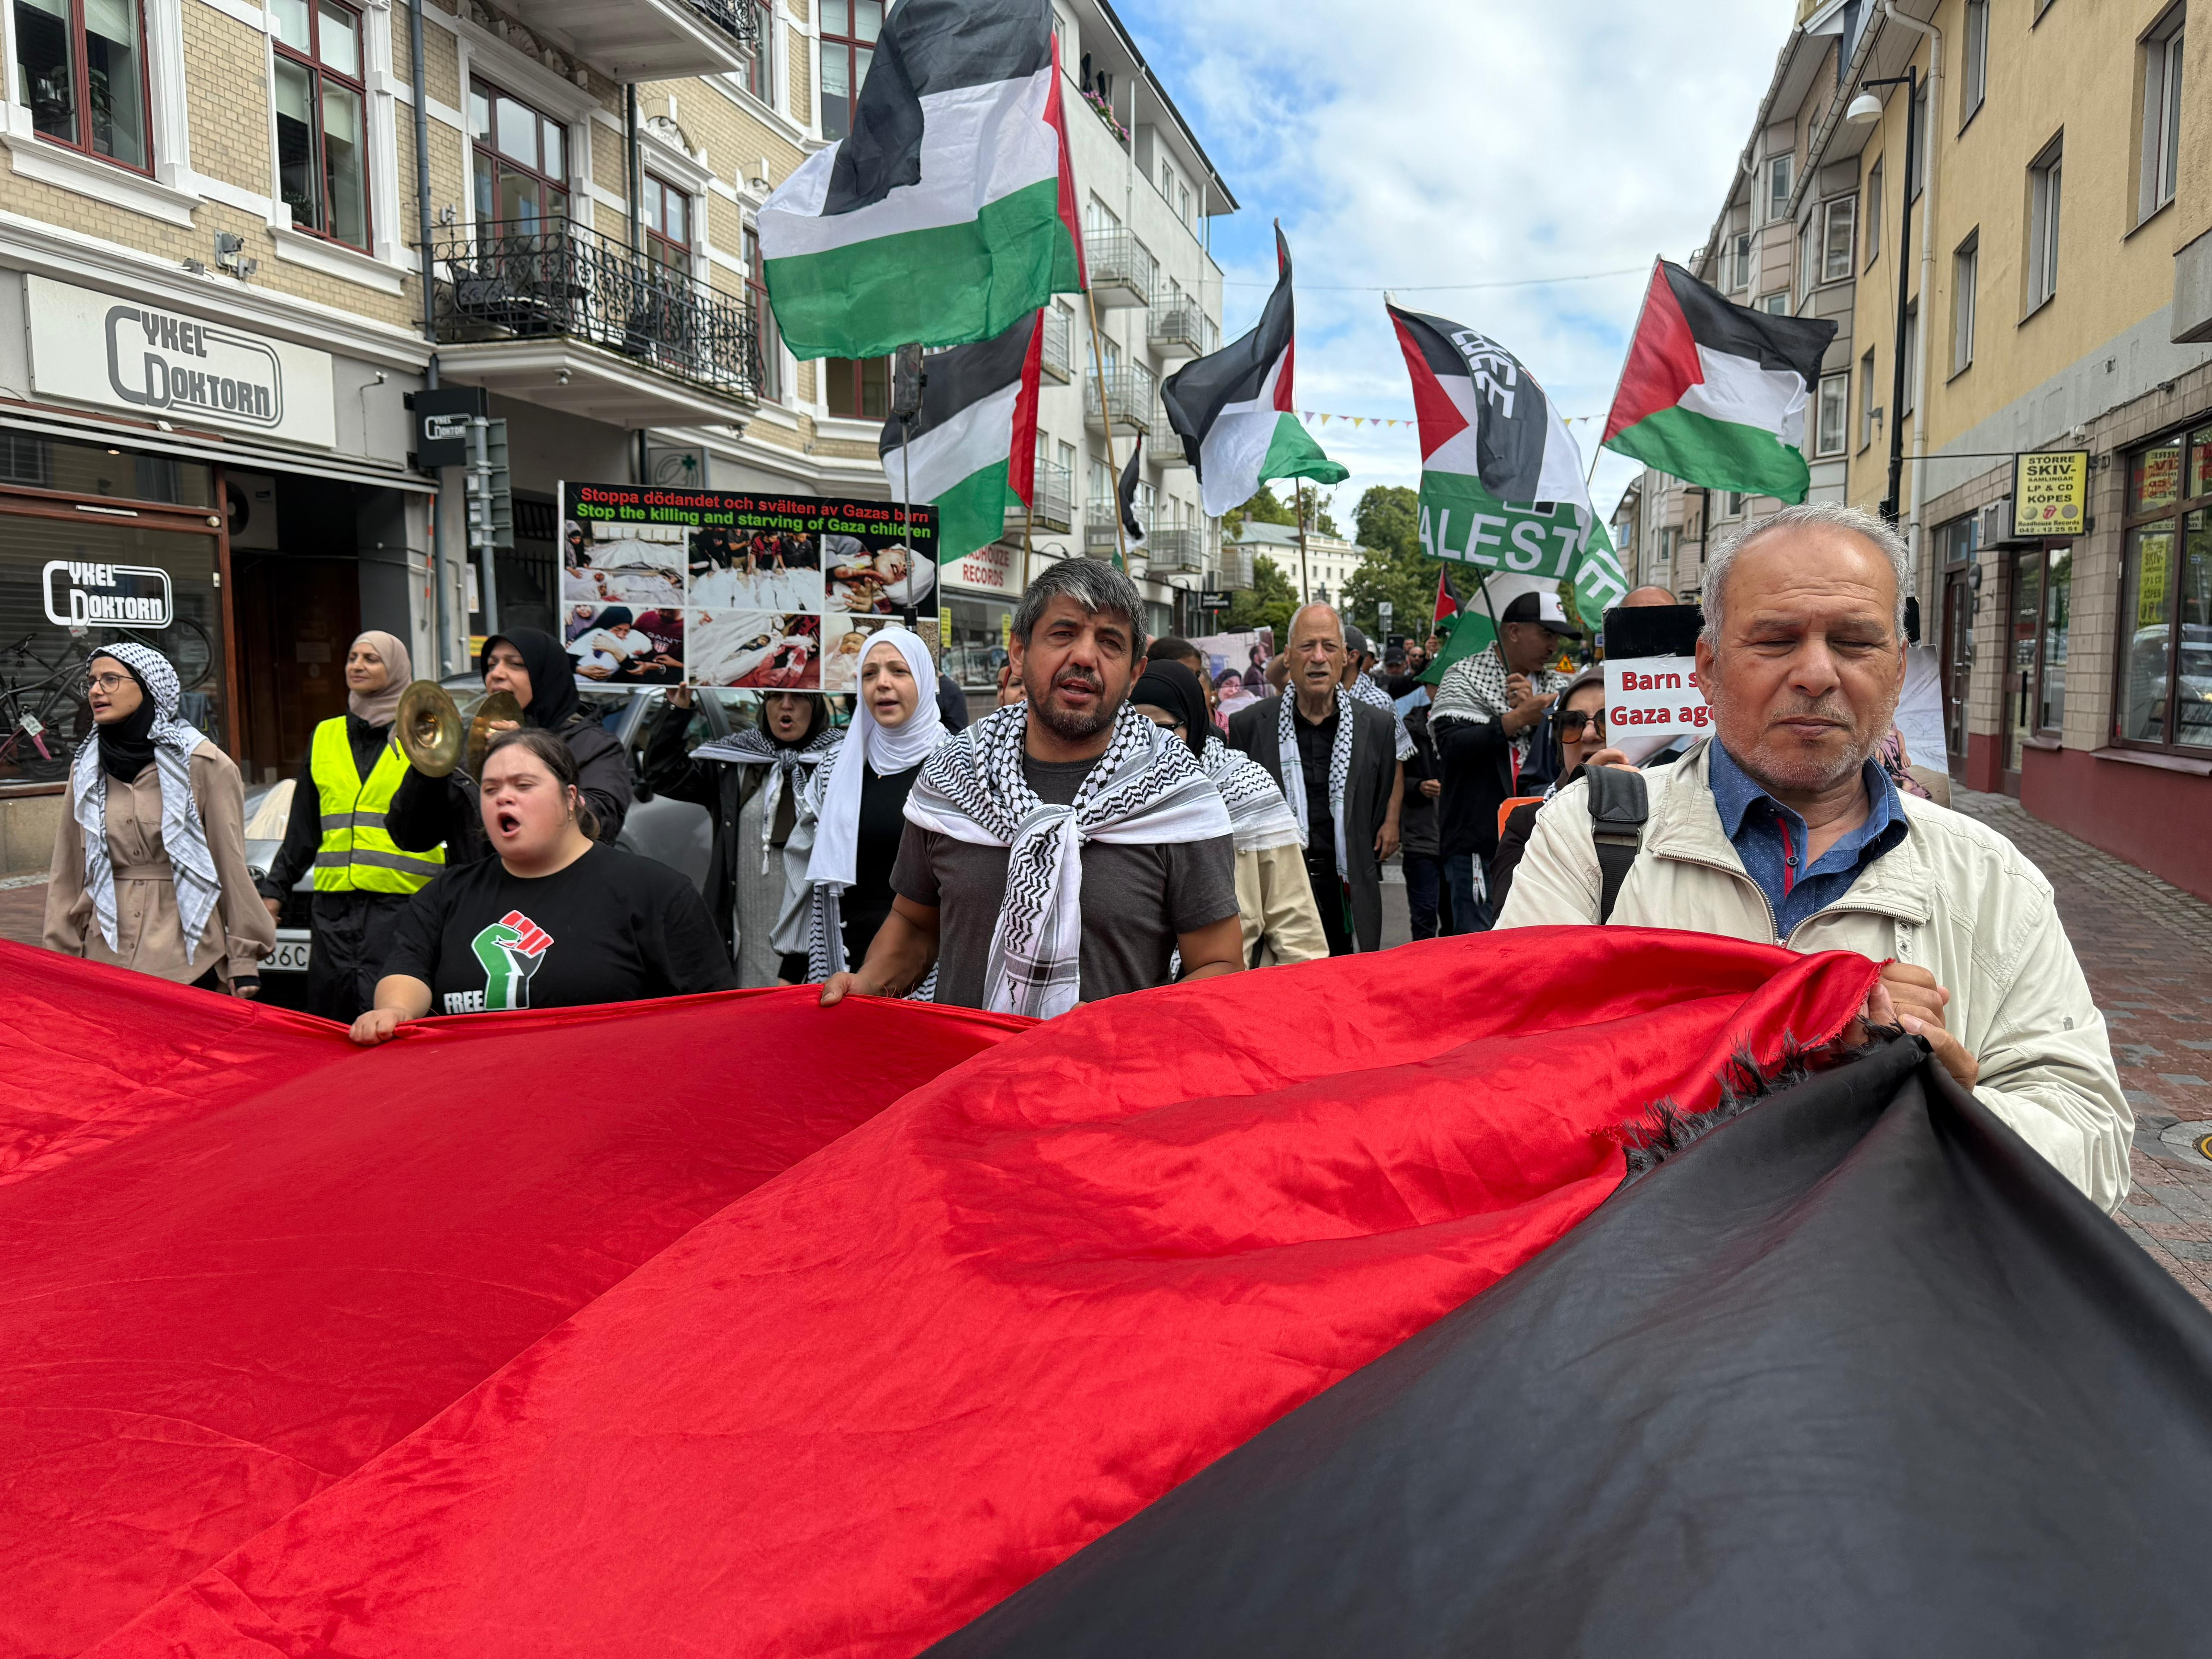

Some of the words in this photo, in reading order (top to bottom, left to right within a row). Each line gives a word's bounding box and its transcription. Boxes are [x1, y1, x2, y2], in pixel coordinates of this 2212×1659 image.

[2029, 455, 2075, 464] STÖRRE
[2027, 464, 2076, 476] SKIV-
[581, 487, 639, 505] Stoppa
[644, 491, 720, 508] dödandet
[724, 496, 753, 511] och
[758, 499, 816, 515] svälten
[821, 505, 839, 516] av
[843, 504, 890, 520] Gazas
[2028, 494, 2072, 503] KÖPES
[576, 502, 616, 521] Stop
[619, 505, 646, 519] the
[650, 507, 699, 526] killing
[704, 511, 734, 525] and
[738, 514, 803, 532] starving
[807, 517, 825, 531] of
[828, 518, 866, 533] Gaza
[963, 563, 1004, 587] RECORDS
[647, 631, 683, 644] GANT
[1622, 671, 1681, 691] Barn
[1610, 706, 1671, 726] Gaza
[443, 990, 484, 1014] FREE
